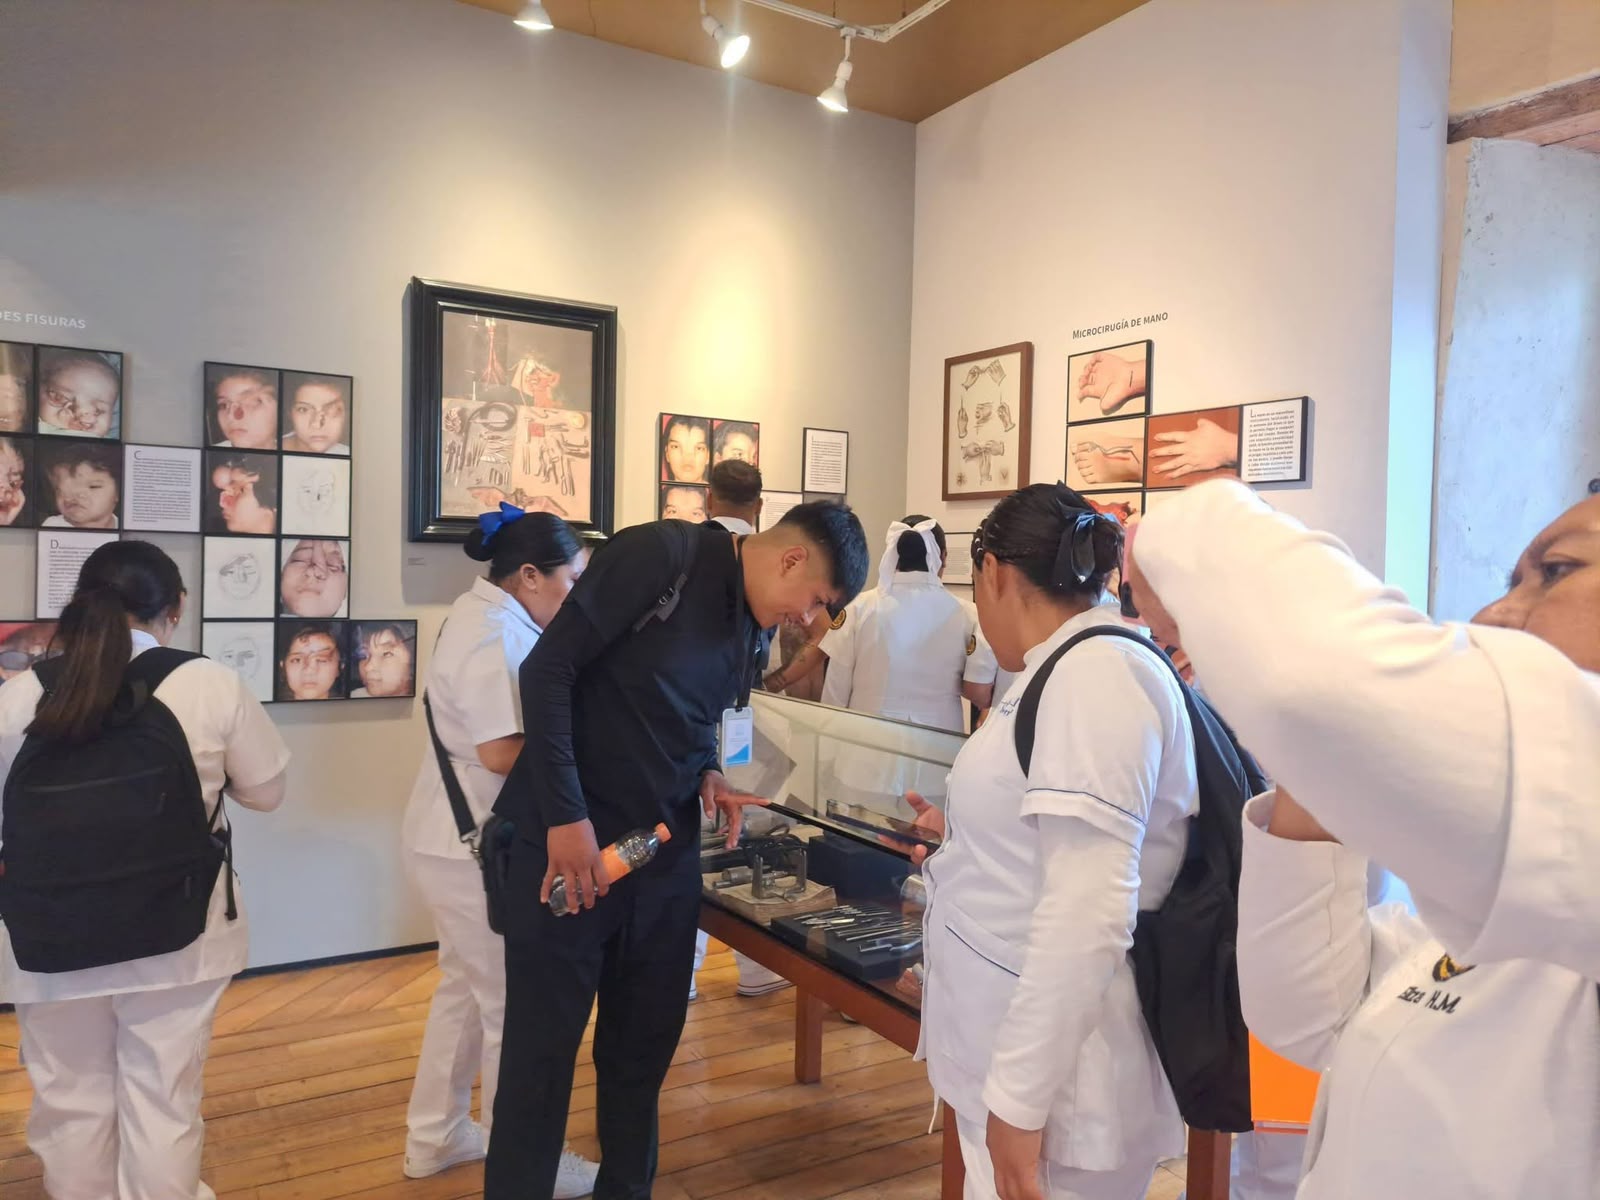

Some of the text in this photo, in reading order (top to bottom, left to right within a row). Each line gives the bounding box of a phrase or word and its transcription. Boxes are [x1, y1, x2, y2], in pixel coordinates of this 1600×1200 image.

[0, 310, 86, 328] ES FISURAS
[1130, 317, 1142, 328] DE
[1143, 311, 1169, 325] MANO
